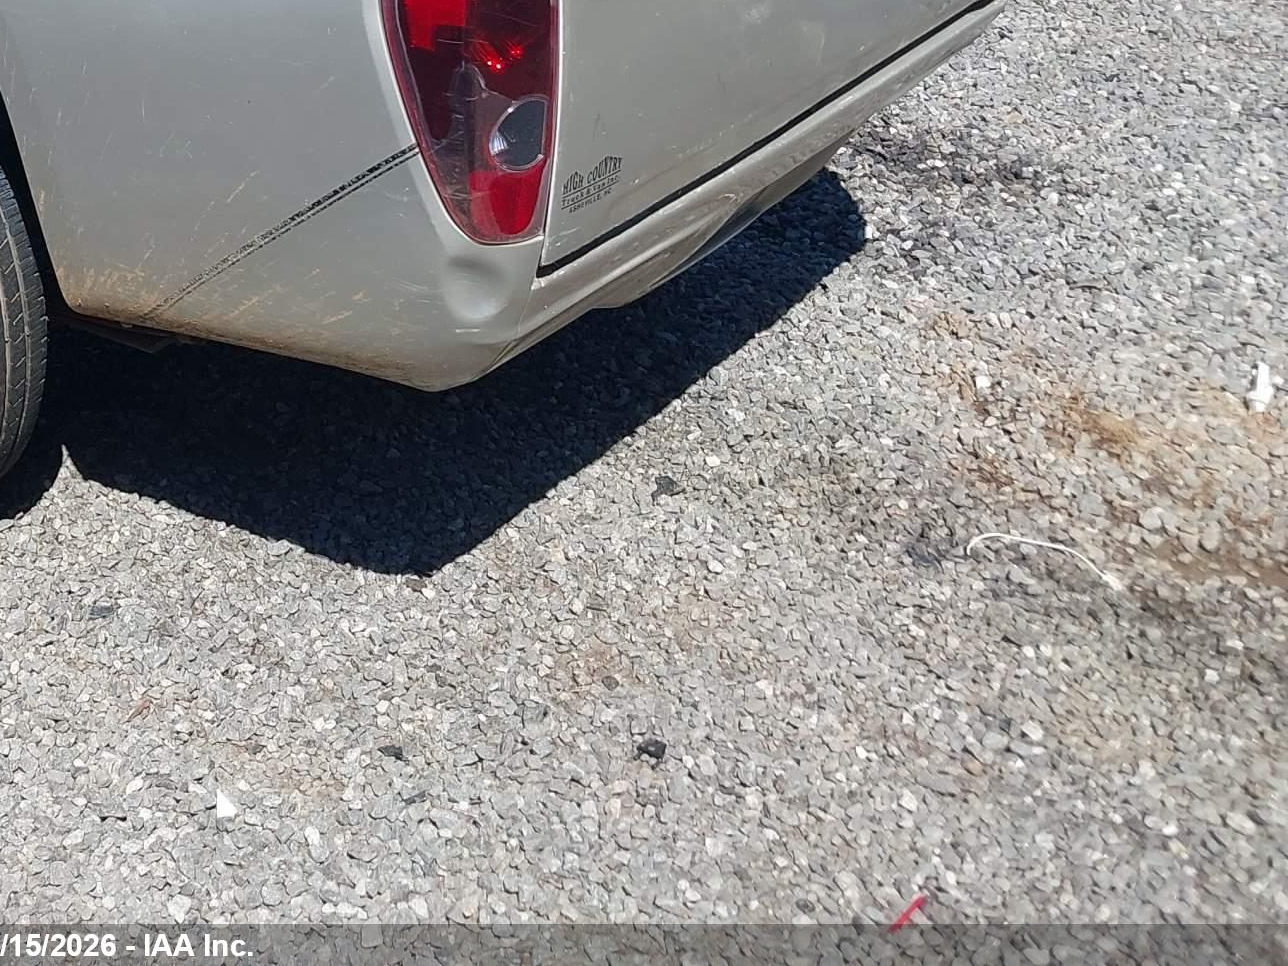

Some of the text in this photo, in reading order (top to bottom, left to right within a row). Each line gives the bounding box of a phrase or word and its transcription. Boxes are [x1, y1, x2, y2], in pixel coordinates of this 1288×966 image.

[562, 155, 622, 195] HIGH COUNTRY
[561, 191, 584, 207] Truck
[592, 182, 606, 191] Van
